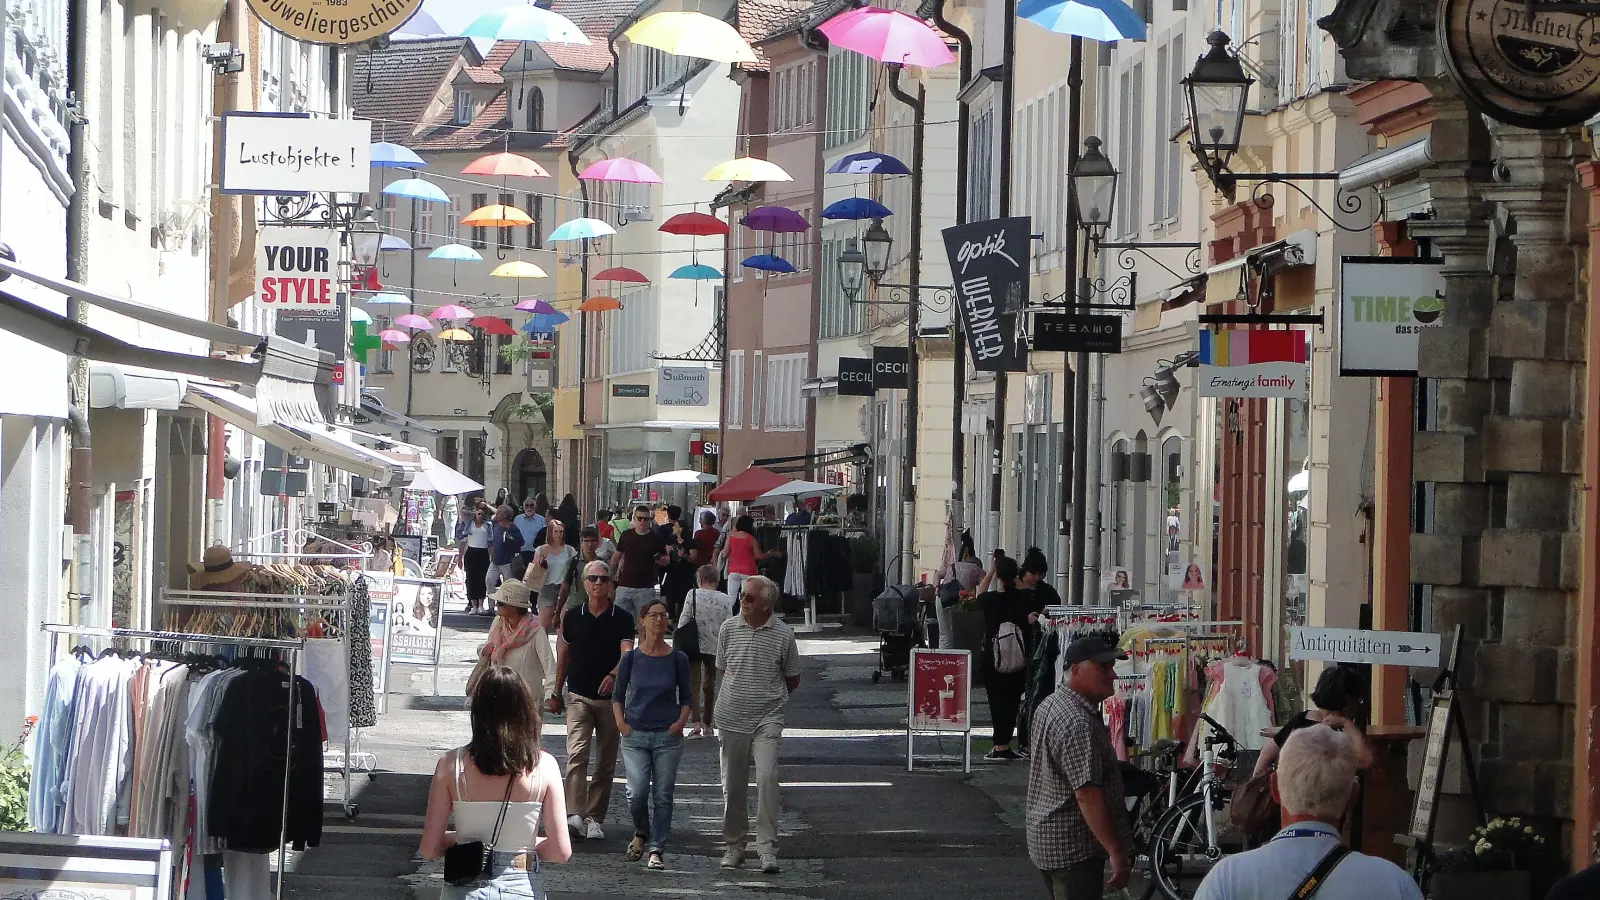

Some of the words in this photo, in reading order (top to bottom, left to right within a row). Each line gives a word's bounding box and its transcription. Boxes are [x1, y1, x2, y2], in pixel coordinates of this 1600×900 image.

[239, 141, 341, 173] Lustobjekte
[263, 245, 329, 273] YOUR
[261, 276, 331, 304] STYLE
[1350, 295, 1411, 323] TIME
[1043, 322, 1113, 334] TEEAMO
[1395, 324, 1412, 334] das
[1210, 376, 1255, 391] Ernsting's
[1257, 374, 1296, 390] family
[1294, 630, 1392, 659] Antiquitäten
